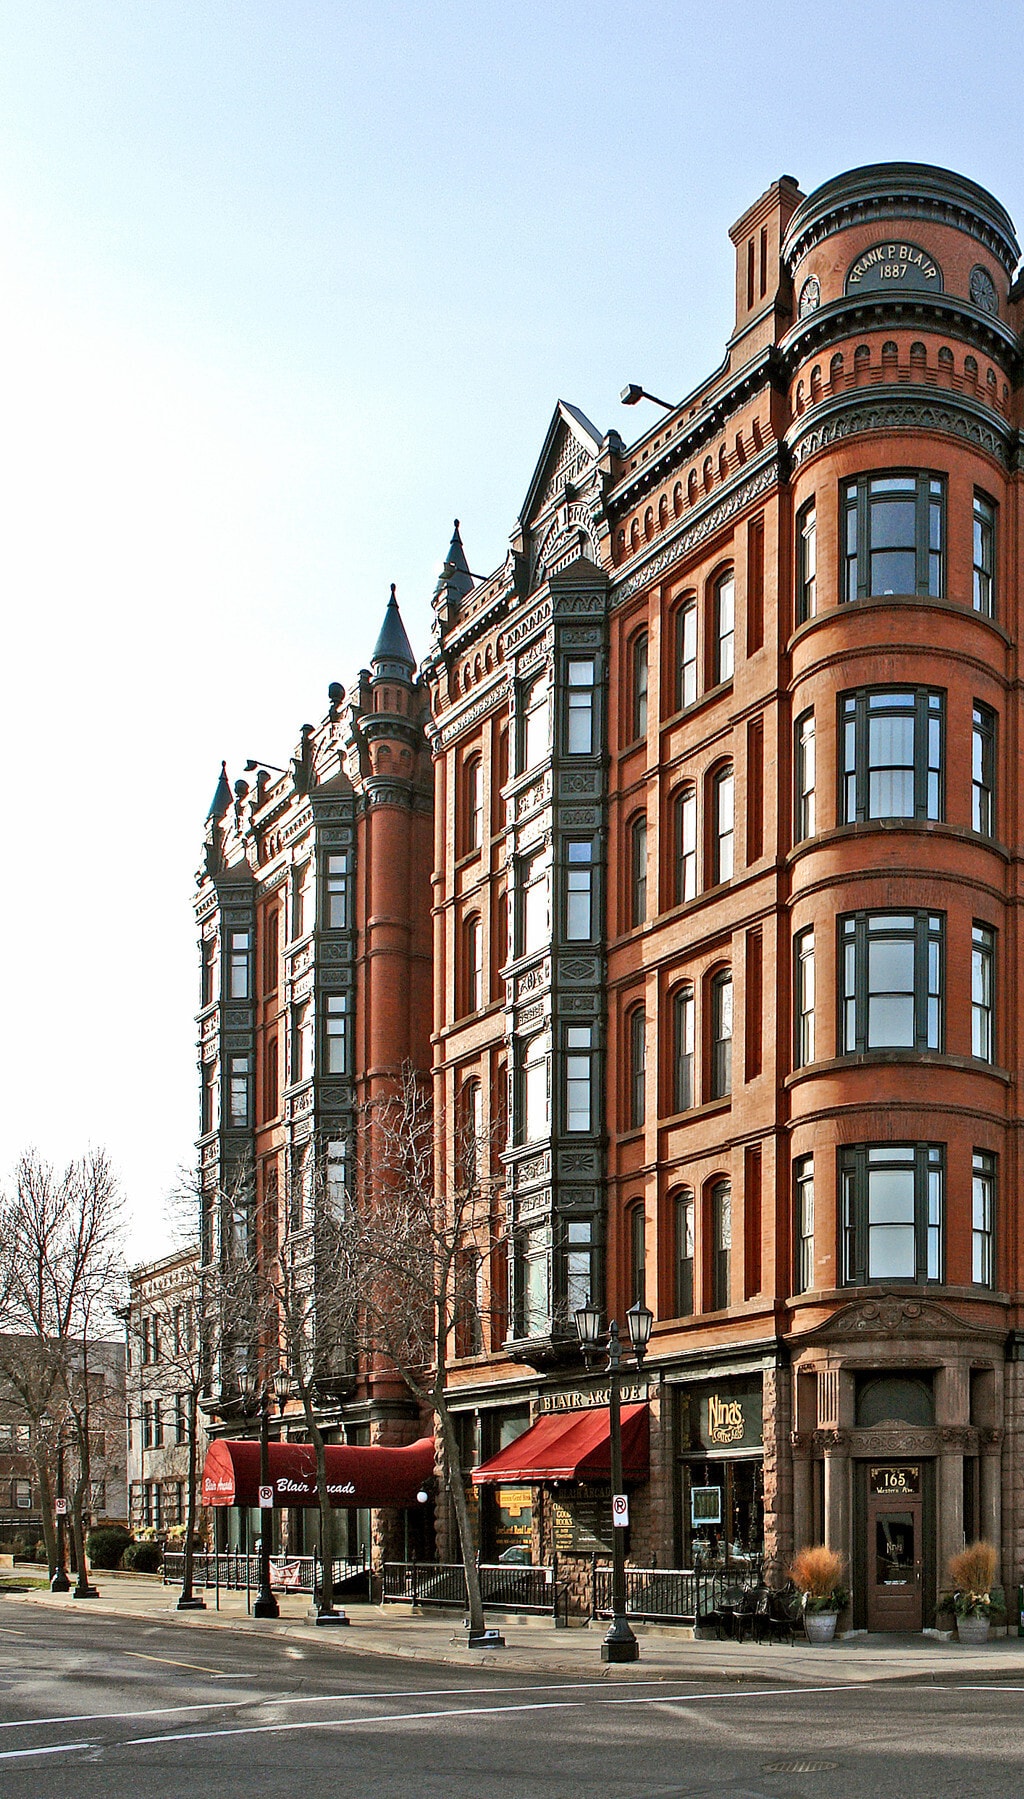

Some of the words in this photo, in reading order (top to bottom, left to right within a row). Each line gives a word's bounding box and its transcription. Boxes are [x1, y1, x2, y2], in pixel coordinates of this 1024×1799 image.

[849, 247, 885, 283] FRANK
[899, 246, 937, 279] BLAIR
[880, 264, 907, 279] 1887
[543, 1393, 583, 1410] BLAIR
[587, 1384, 639, 1405] ARCDE
[708, 1394, 742, 1437] Nina's
[276, 1478, 309, 1492] Blair
[884, 1473, 906, 1487] 165
